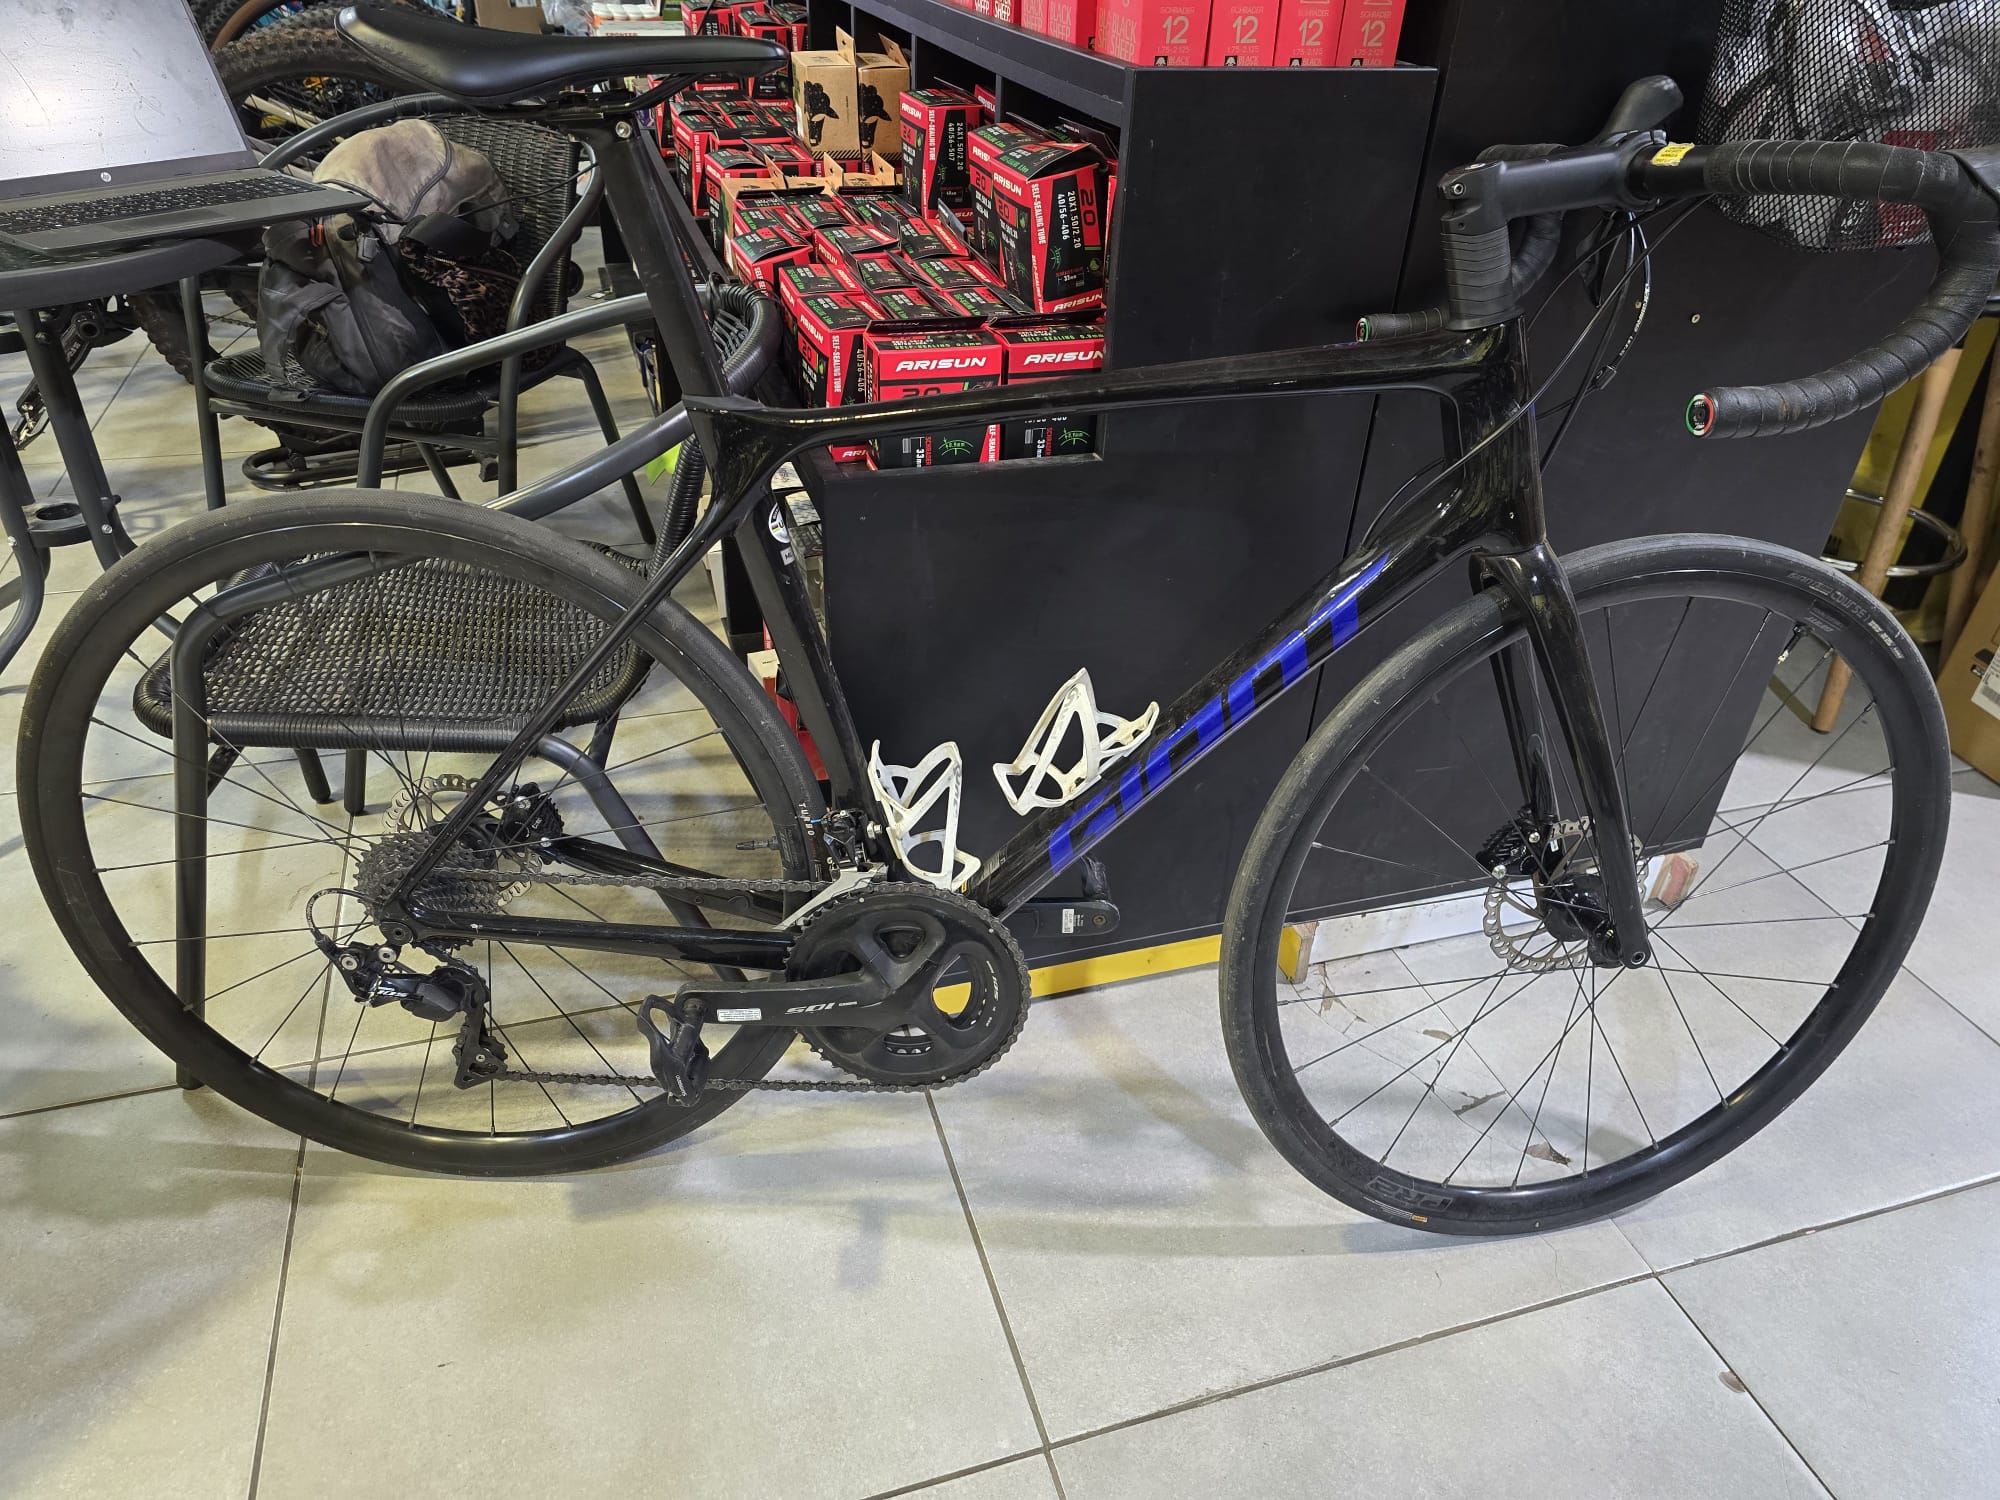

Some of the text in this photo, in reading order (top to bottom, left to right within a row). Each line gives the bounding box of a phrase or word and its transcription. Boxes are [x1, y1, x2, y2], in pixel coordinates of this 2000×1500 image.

[1050, 2, 1072, 26] BLACK
[1112, 13, 1136, 44] BLACK
[1163, 15, 1190, 44] 12
[1232, 16, 1258, 44] 12
[1298, 18, 1324, 46] 12
[1362, 20, 1386, 46] 12
[1110, 36, 1135, 61] SHEEP
[994, 172, 1022, 197] ARISUN
[1081, 188, 1096, 226] 20
[1053, 292, 1103, 312] ARISUN
[800, 314, 824, 344] ARISUN
[896, 356, 987, 372] ARISUN
[784, 1002, 835, 1015] 105
